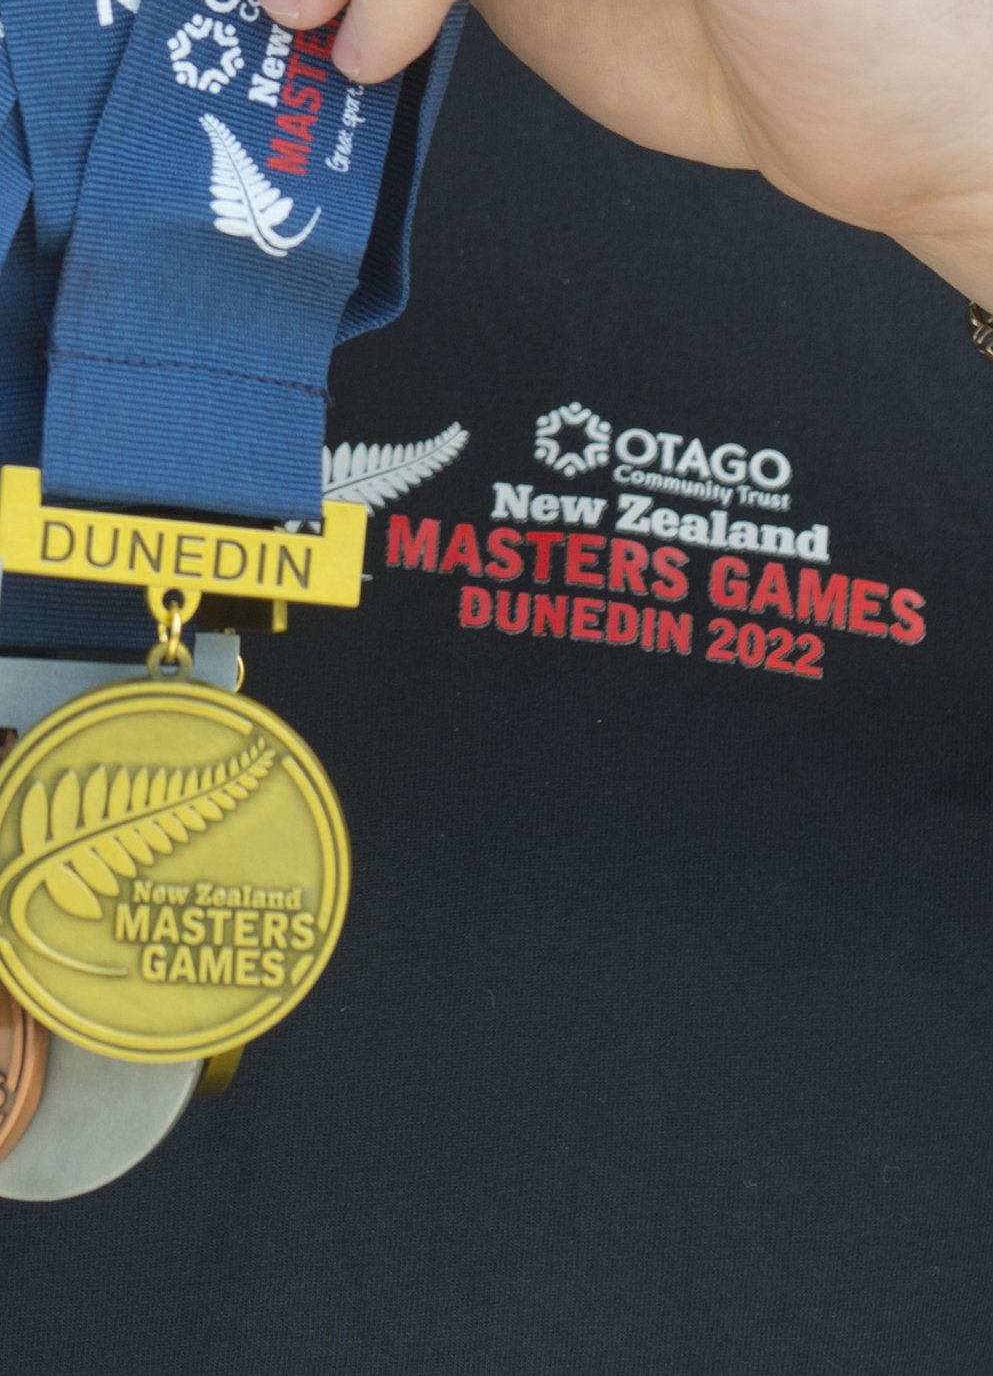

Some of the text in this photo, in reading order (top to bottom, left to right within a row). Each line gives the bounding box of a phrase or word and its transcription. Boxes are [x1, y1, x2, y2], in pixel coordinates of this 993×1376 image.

[248, 24, 294, 108] New
[266, 15, 342, 176] MASTE
[613, 464, 792, 512] Community Trust
[615, 427, 792, 490] OTAGO
[40, 521, 313, 590] DUNEDIN
[491, 482, 830, 563] New Zealand
[386, 514, 926, 645] MASTERS GAMES
[459, 586, 824, 679] DUNEDIN 2022
[115, 903, 315, 949] MASTERS
[133, 880, 302, 910] New Zealand
[142, 944, 286, 988] GAMES
